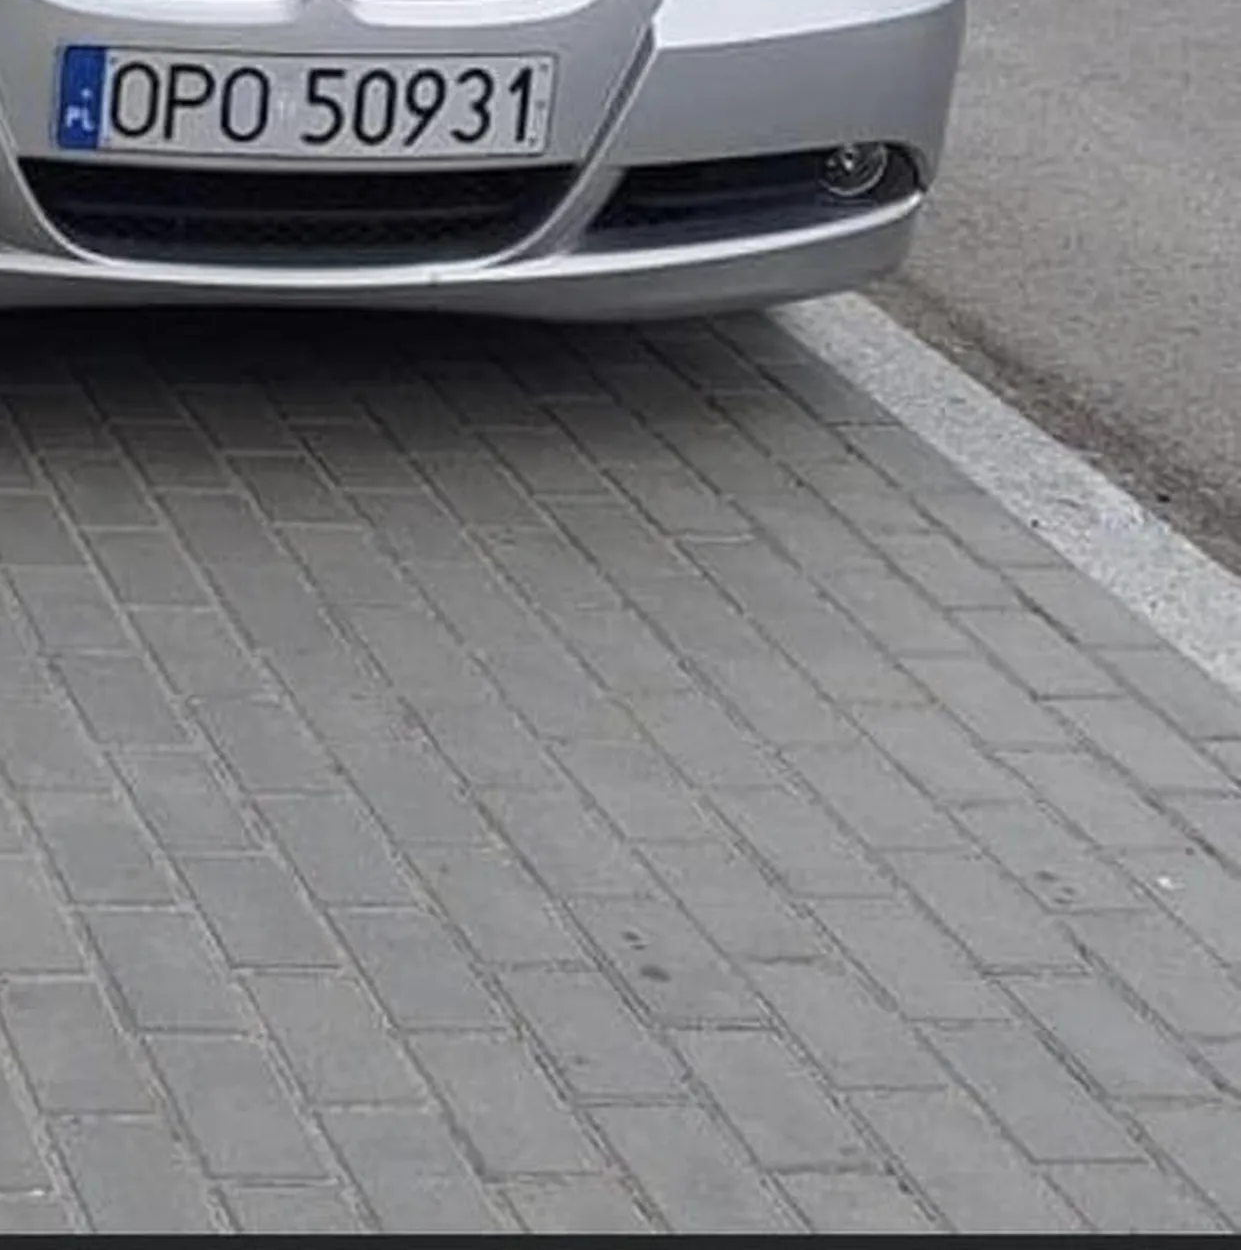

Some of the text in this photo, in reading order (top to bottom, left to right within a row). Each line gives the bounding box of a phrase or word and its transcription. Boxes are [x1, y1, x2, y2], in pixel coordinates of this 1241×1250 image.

[64, 106, 95, 133] PL
[109, 61, 534, 147] OPO 50931
